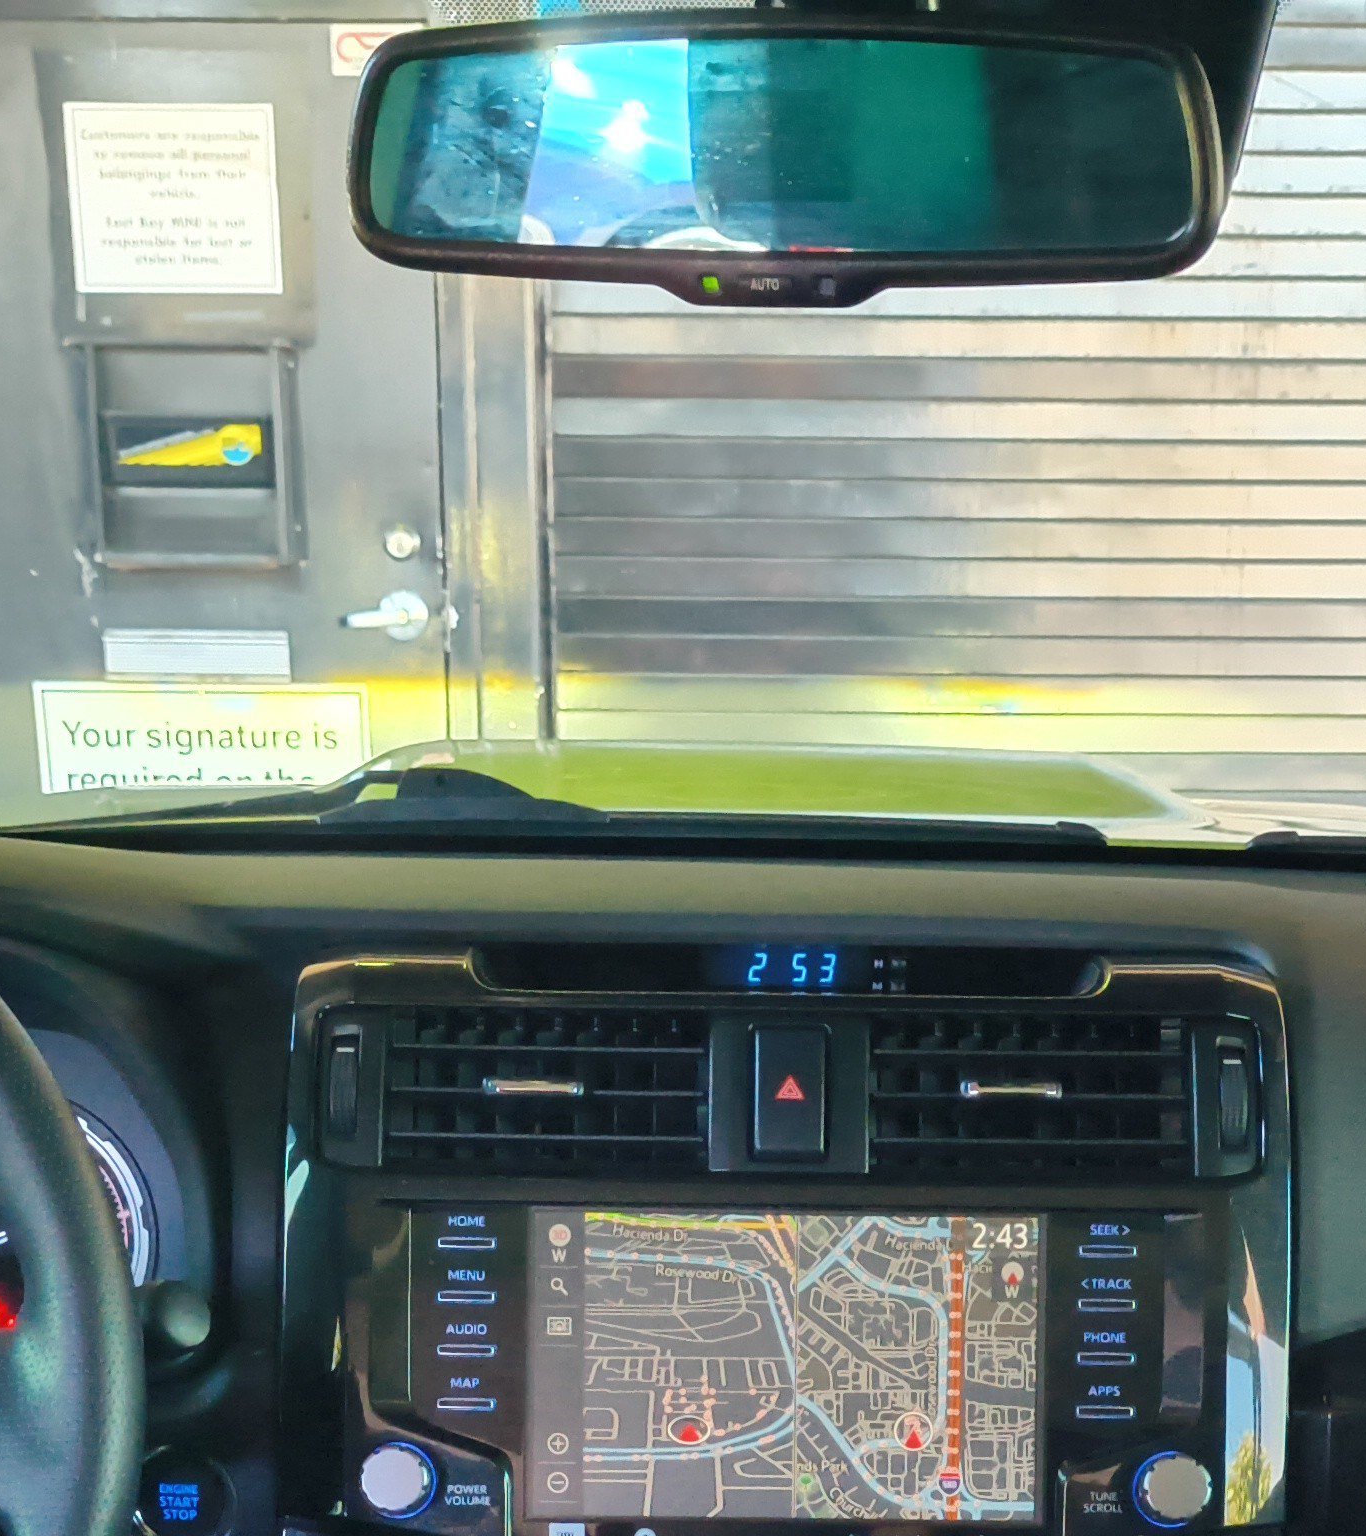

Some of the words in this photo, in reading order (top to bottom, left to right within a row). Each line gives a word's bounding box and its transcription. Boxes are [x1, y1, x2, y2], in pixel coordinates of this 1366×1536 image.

[750, 277, 780, 291] AUTO
[62, 720, 137, 749] Your
[146, 720, 302, 756] signature
[314, 721, 339, 749] is
[448, 1215, 486, 1228] HOME
[612, 1223, 671, 1242] Hacienda
[971, 1222, 1029, 1250] 2:43
[1089, 1223, 1120, 1236] SEEK
[551, 1249, 567, 1263] W
[448, 1269, 486, 1282] MENU
[655, 1262, 720, 1282] Rosewood
[1091, 1277, 1133, 1291] TRACK
[1004, 1285, 1020, 1299] W
[446, 1323, 488, 1336] AUDIO
[1083, 1331, 1127, 1344] PHONE
[450, 1377, 480, 1390] MAP
[1088, 1384, 1122, 1397] APPS
[158, 1483, 199, 1495] ENGINE
[446, 1484, 488, 1495] POWER
[158, 1495, 200, 1508] START
[444, 1495, 492, 1507] VOLUME
[1089, 1490, 1119, 1502] TUNE
[162, 1508, 198, 1521] STOP
[1082, 1502, 1124, 1514] SCROLL
